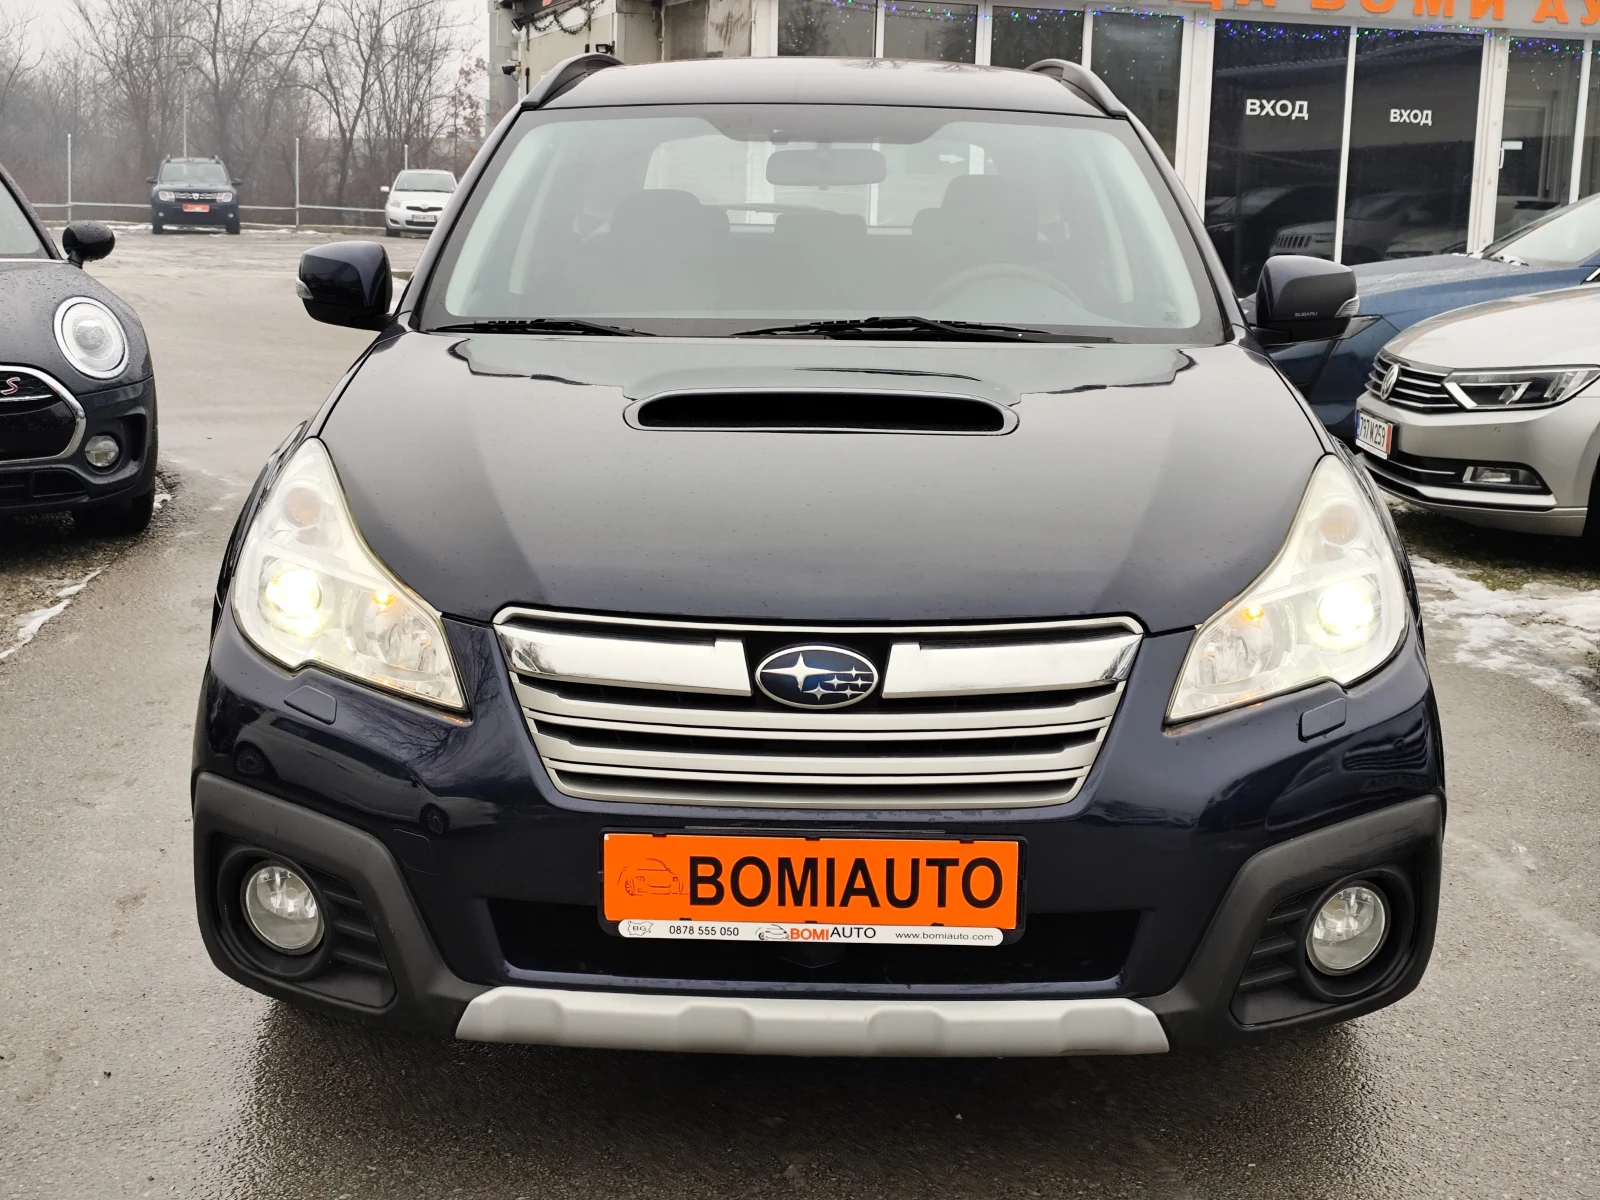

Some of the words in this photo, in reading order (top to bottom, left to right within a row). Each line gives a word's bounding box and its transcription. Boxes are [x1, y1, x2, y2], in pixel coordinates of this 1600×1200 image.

[1245, 98, 1309, 121] ВХОД
[1389, 108, 1433, 126] ВХОД
[689, 855, 1003, 909] BOMIAUTO
[632, 925, 647, 934] BG
[668, 925, 695, 935] 0878
[697, 925, 717, 936] 555
[719, 926, 740, 937] 050
[895, 931, 994, 941] www.bomiauto.com
